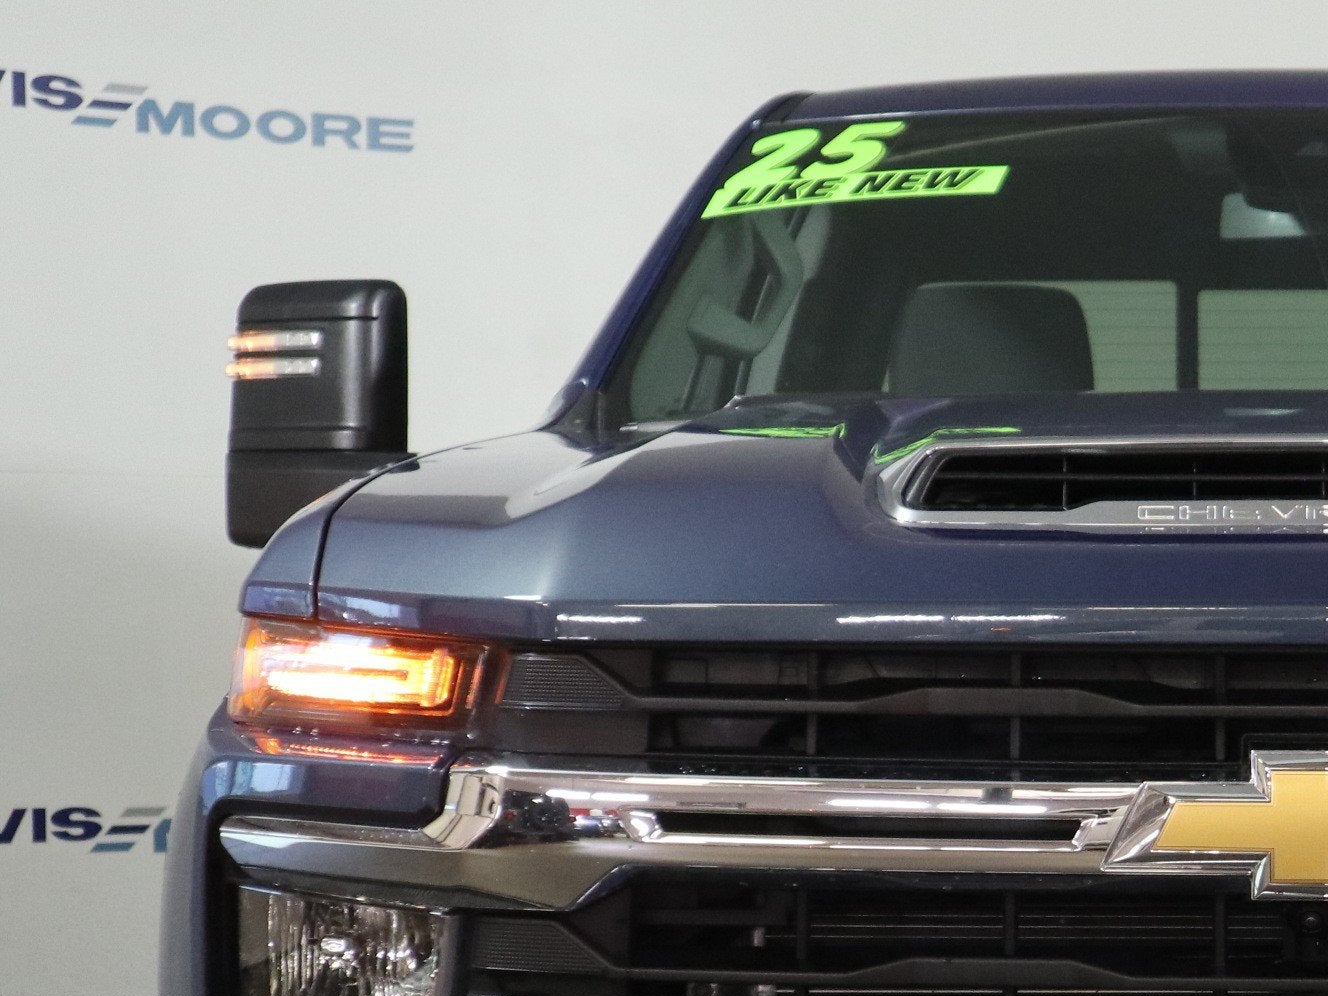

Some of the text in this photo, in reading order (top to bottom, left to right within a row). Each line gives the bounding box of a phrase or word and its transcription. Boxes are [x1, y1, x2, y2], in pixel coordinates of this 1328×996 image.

[0, 70, 416, 153] IS MOORE
[723, 121, 906, 188] 25
[723, 168, 983, 210] LIKE NEW
